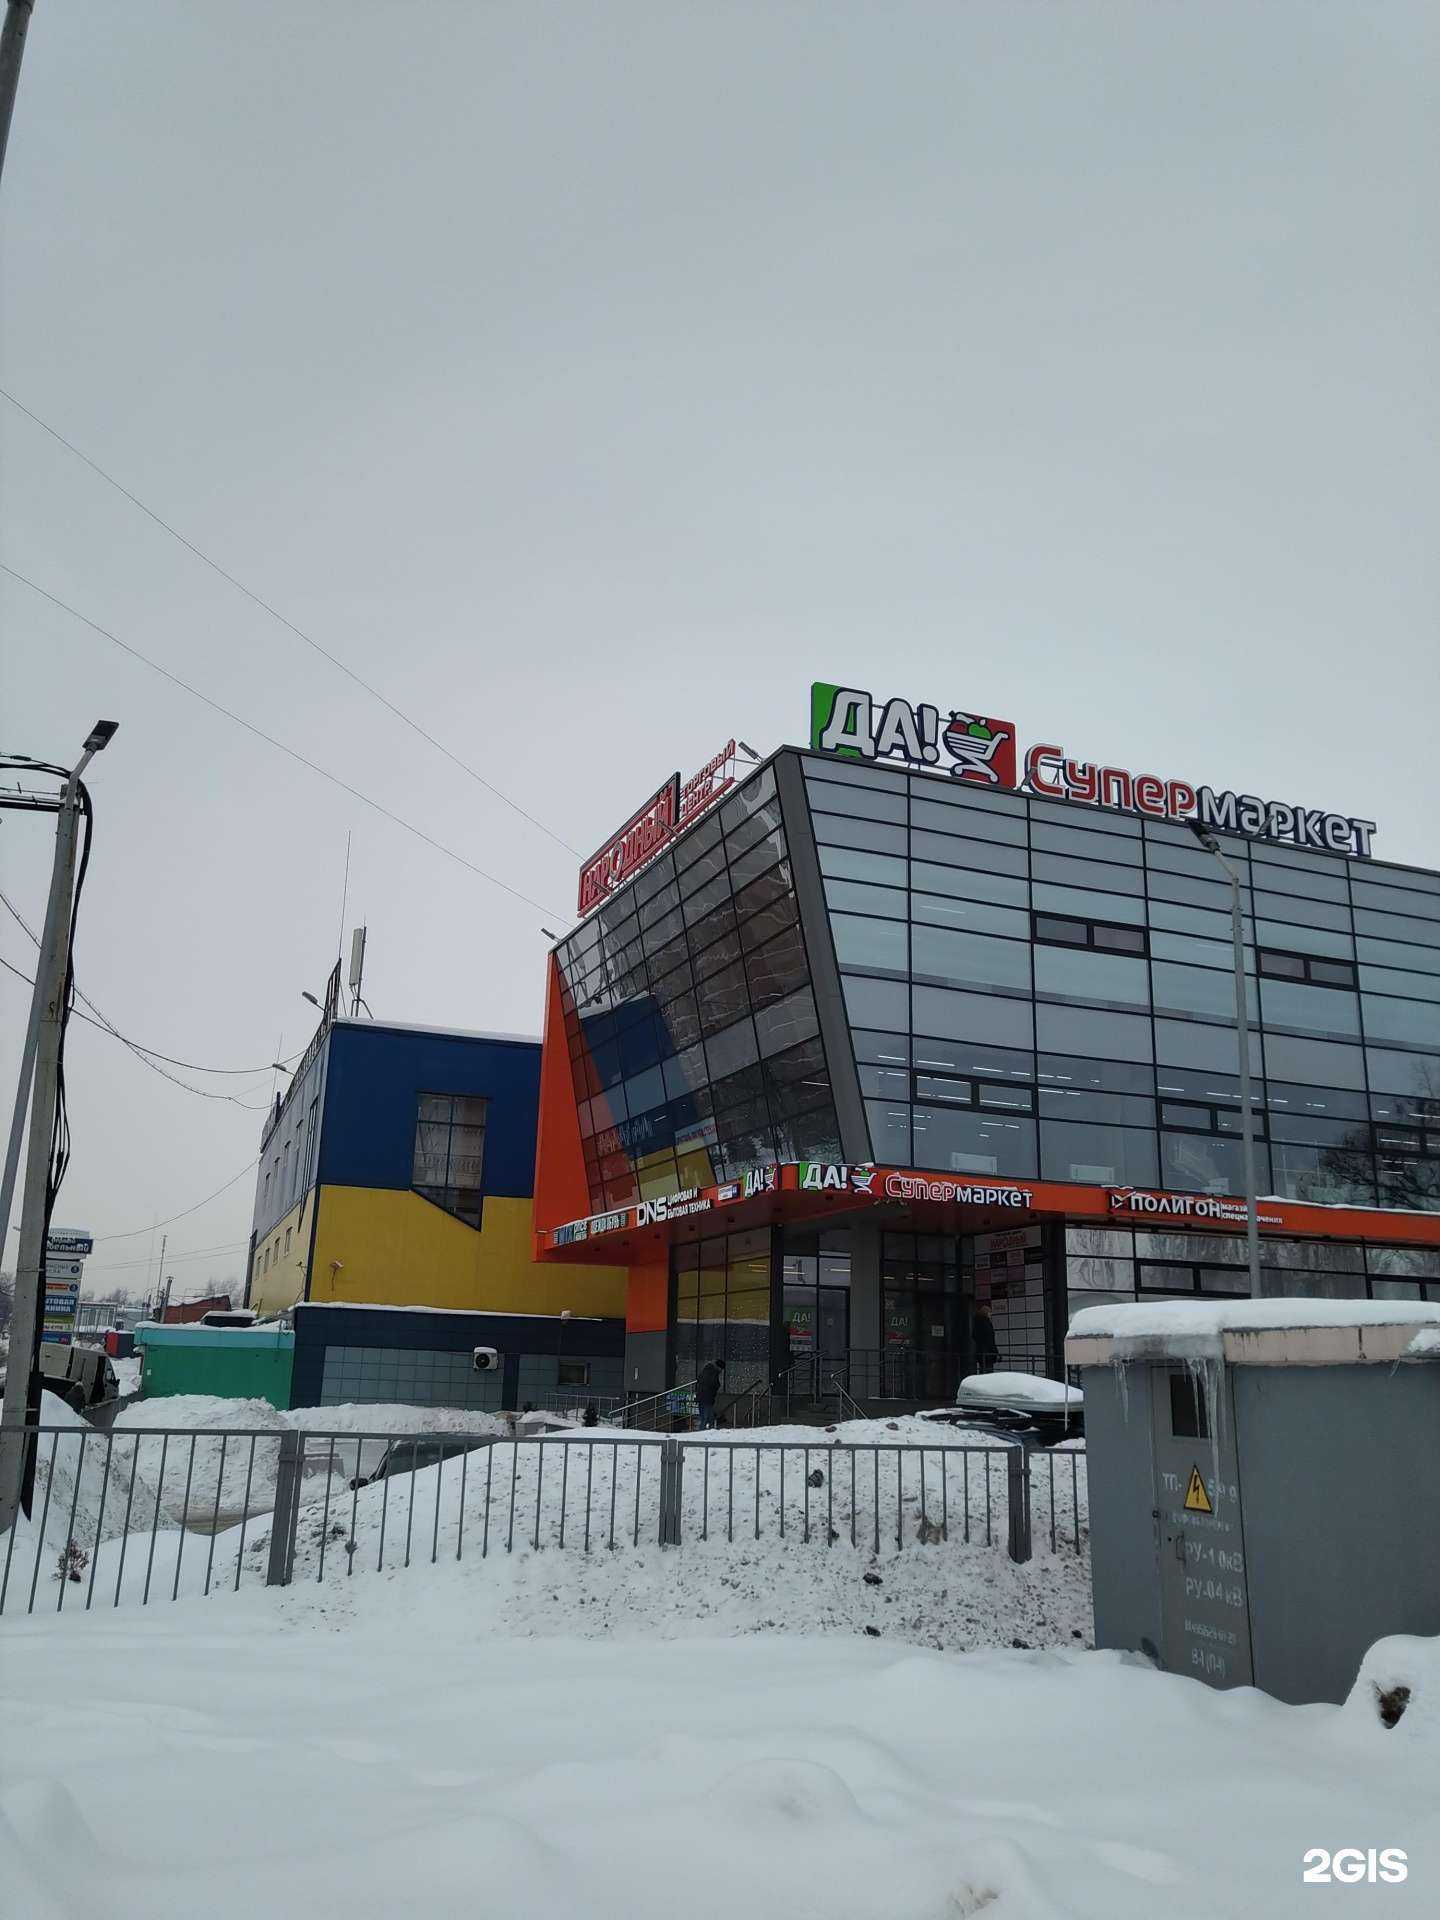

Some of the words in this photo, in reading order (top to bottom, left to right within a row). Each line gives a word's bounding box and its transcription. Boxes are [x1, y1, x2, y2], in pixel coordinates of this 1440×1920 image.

[819, 687, 940, 765] ДА!
[1024, 743, 1377, 859] Супермаркет
[582, 783, 674, 906] НАРОДНЫЙ
[744, 1168, 765, 1199] ДА!
[802, 1163, 848, 1190] ДА!
[885, 1172, 1033, 1208] Супермаркет
[636, 1197, 668, 1227] DNS
[688, 1198, 711, 1214] ТЕХНИКА
[1131, 1195, 1221, 1218] ПОЛИГОН
[1221, 1203, 1249, 1212] магази
[792, 1311, 811, 1322] ДА!
